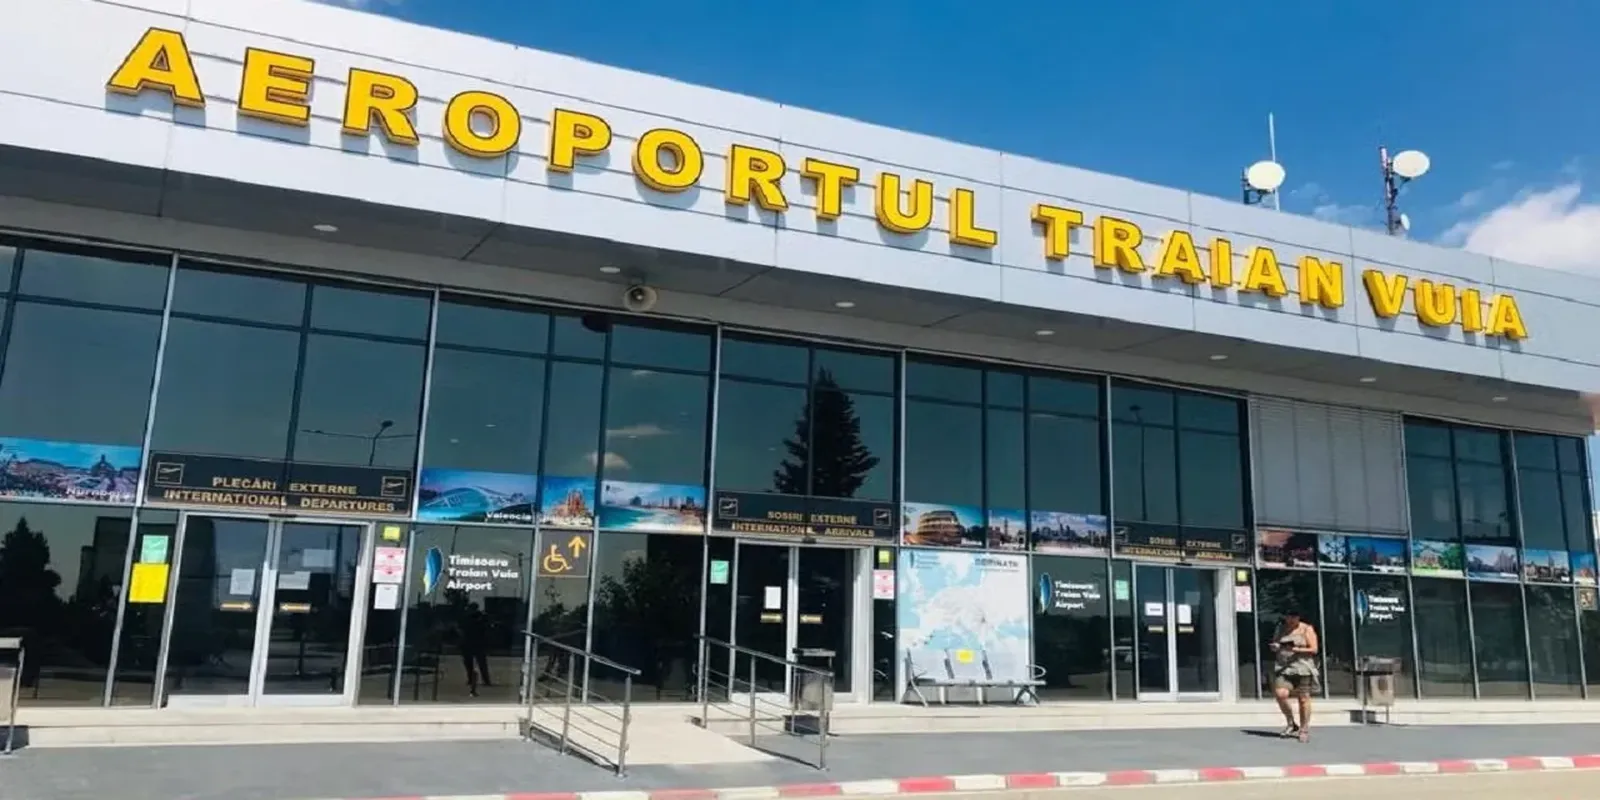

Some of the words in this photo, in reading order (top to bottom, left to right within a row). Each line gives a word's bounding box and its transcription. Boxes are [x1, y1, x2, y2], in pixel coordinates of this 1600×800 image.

[106, 27, 998, 248] AEROPORTUL
[1031, 203, 1345, 310] TRAIAN
[1363, 268, 1528, 340] VUIA
[289, 482, 357, 495] EXTERNE
[164, 489, 287, 506] INTERNATIONAL
[301, 497, 395, 512] DEPARTURES
[486, 511, 532, 521] Valencia
[767, 510, 803, 521] SOSIRI
[811, 514, 858, 525] EXTERNE
[824, 527, 875, 538] ARRIVALS
[448, 568, 488, 578] Traian
[491, 569, 519, 579] Vuia
[446, 581, 492, 592] Airport
